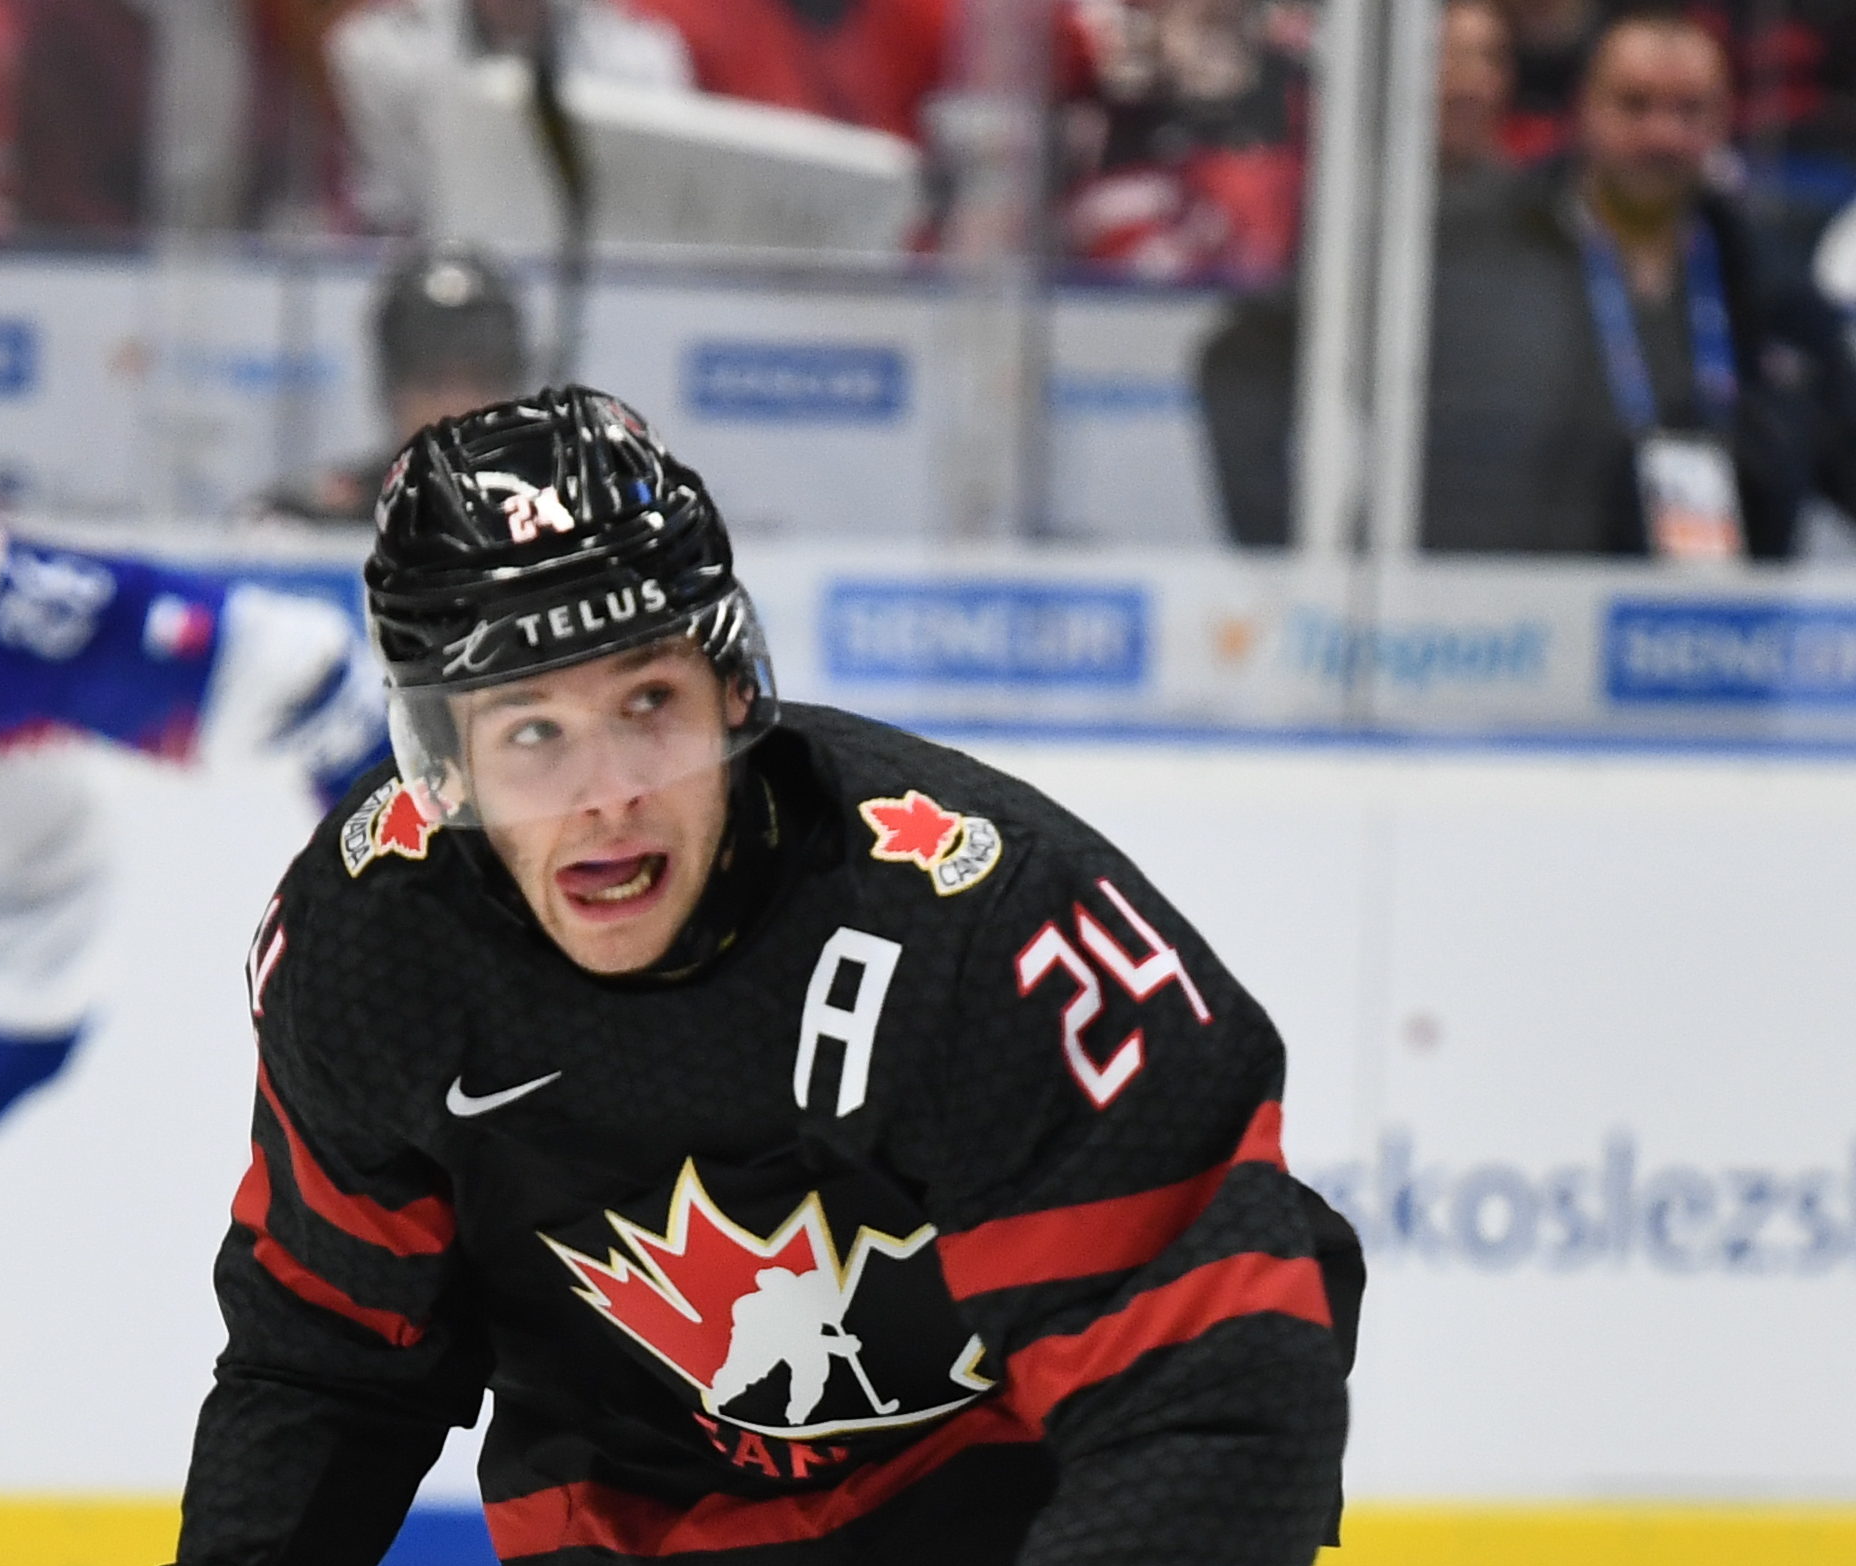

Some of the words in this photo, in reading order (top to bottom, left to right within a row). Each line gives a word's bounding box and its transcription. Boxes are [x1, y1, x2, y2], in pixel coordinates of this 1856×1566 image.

[516, 578, 667, 648] TELUS
[793, 925, 903, 1118] A
[1014, 876, 1212, 1110] 24
